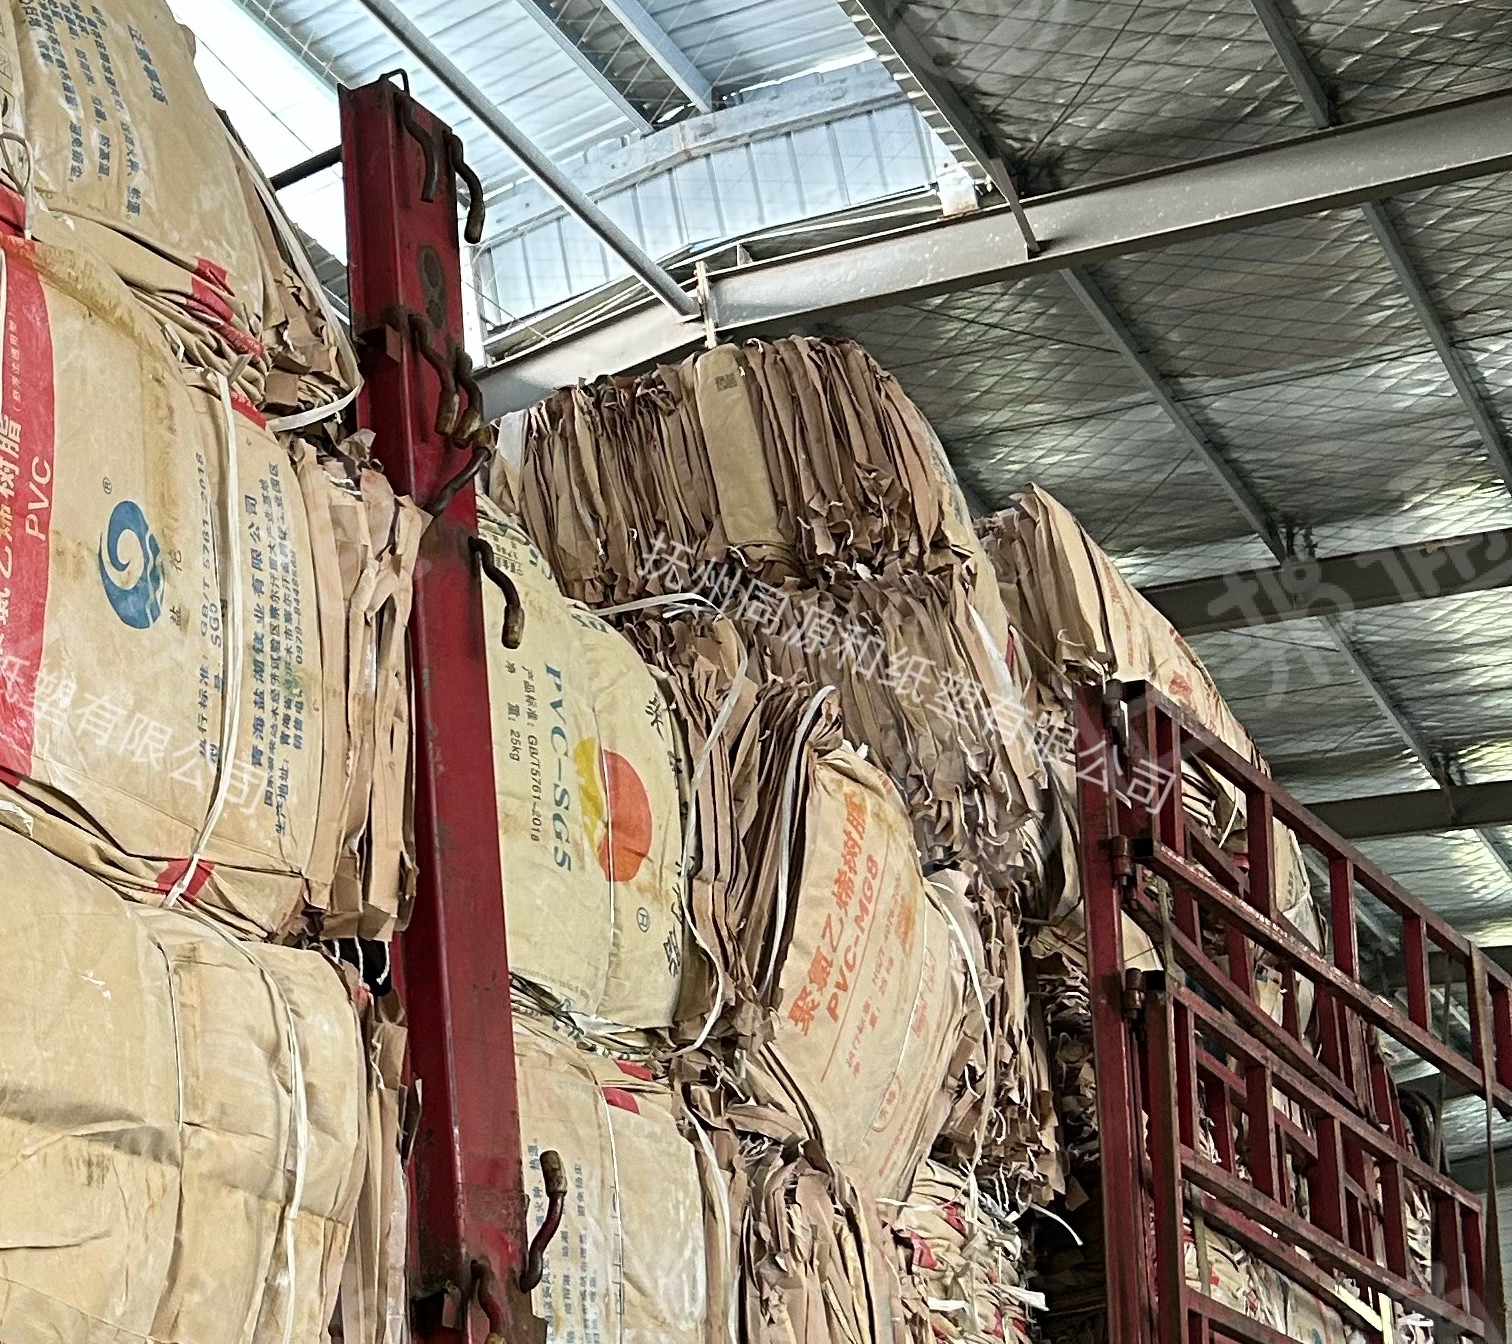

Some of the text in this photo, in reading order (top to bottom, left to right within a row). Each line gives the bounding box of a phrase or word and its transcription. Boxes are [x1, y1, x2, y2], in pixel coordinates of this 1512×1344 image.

[128, 24, 168, 105] 注意事项
[25, 455, 53, 541] PVC
[506, 728, 523, 762] 25kg
[543, 660, 573, 872] PVC-SG5
[787, 791, 867, 1036] 聚氯乙烯树脂
[826, 853, 880, 1023] PVC-MG8
